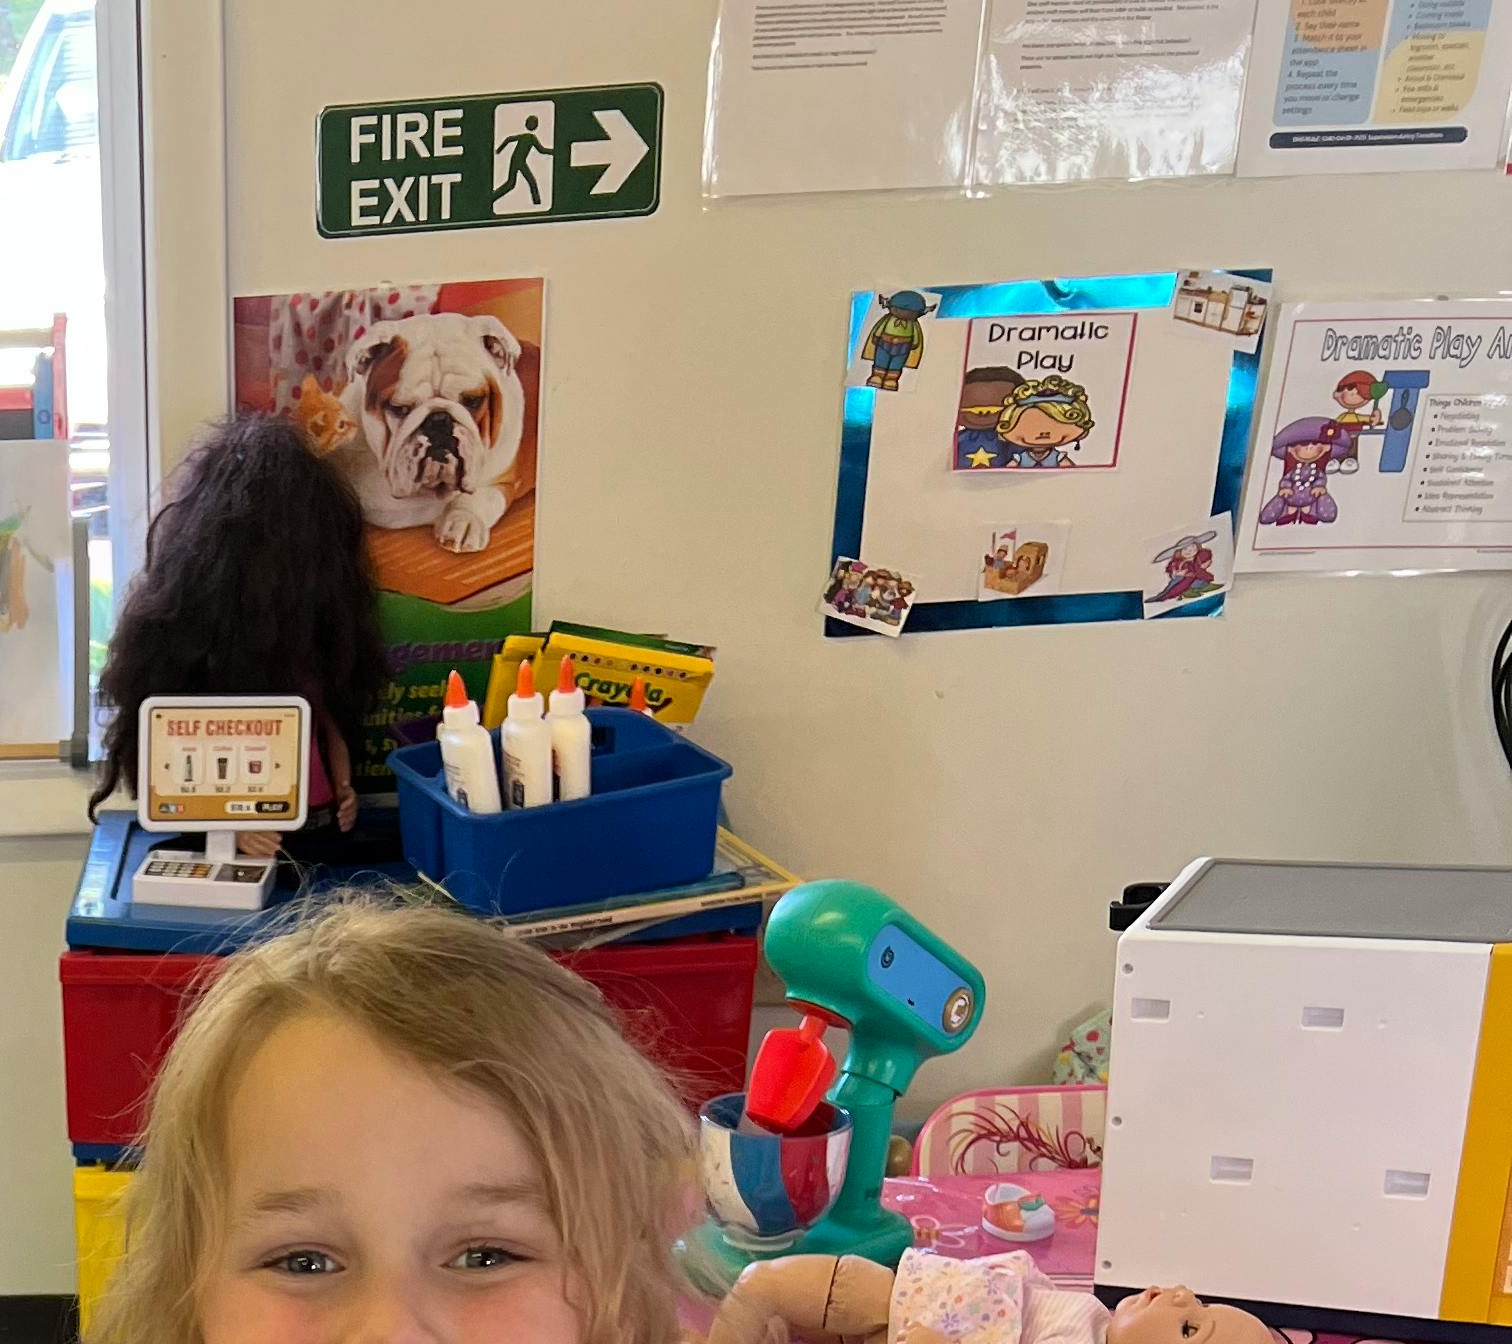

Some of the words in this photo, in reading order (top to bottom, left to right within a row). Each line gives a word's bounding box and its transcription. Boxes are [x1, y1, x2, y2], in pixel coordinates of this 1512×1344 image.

[350, 109, 464, 164] FIRE
[350, 173, 463, 227] EXIT
[987, 320, 1110, 343] Dramatic
[1320, 326, 1424, 363] Dramatic
[1428, 325, 1483, 369] Play
[1017, 350, 1076, 374] Play
[167, 719, 201, 737] SELF
[205, 719, 283, 737] CHECKOUT
